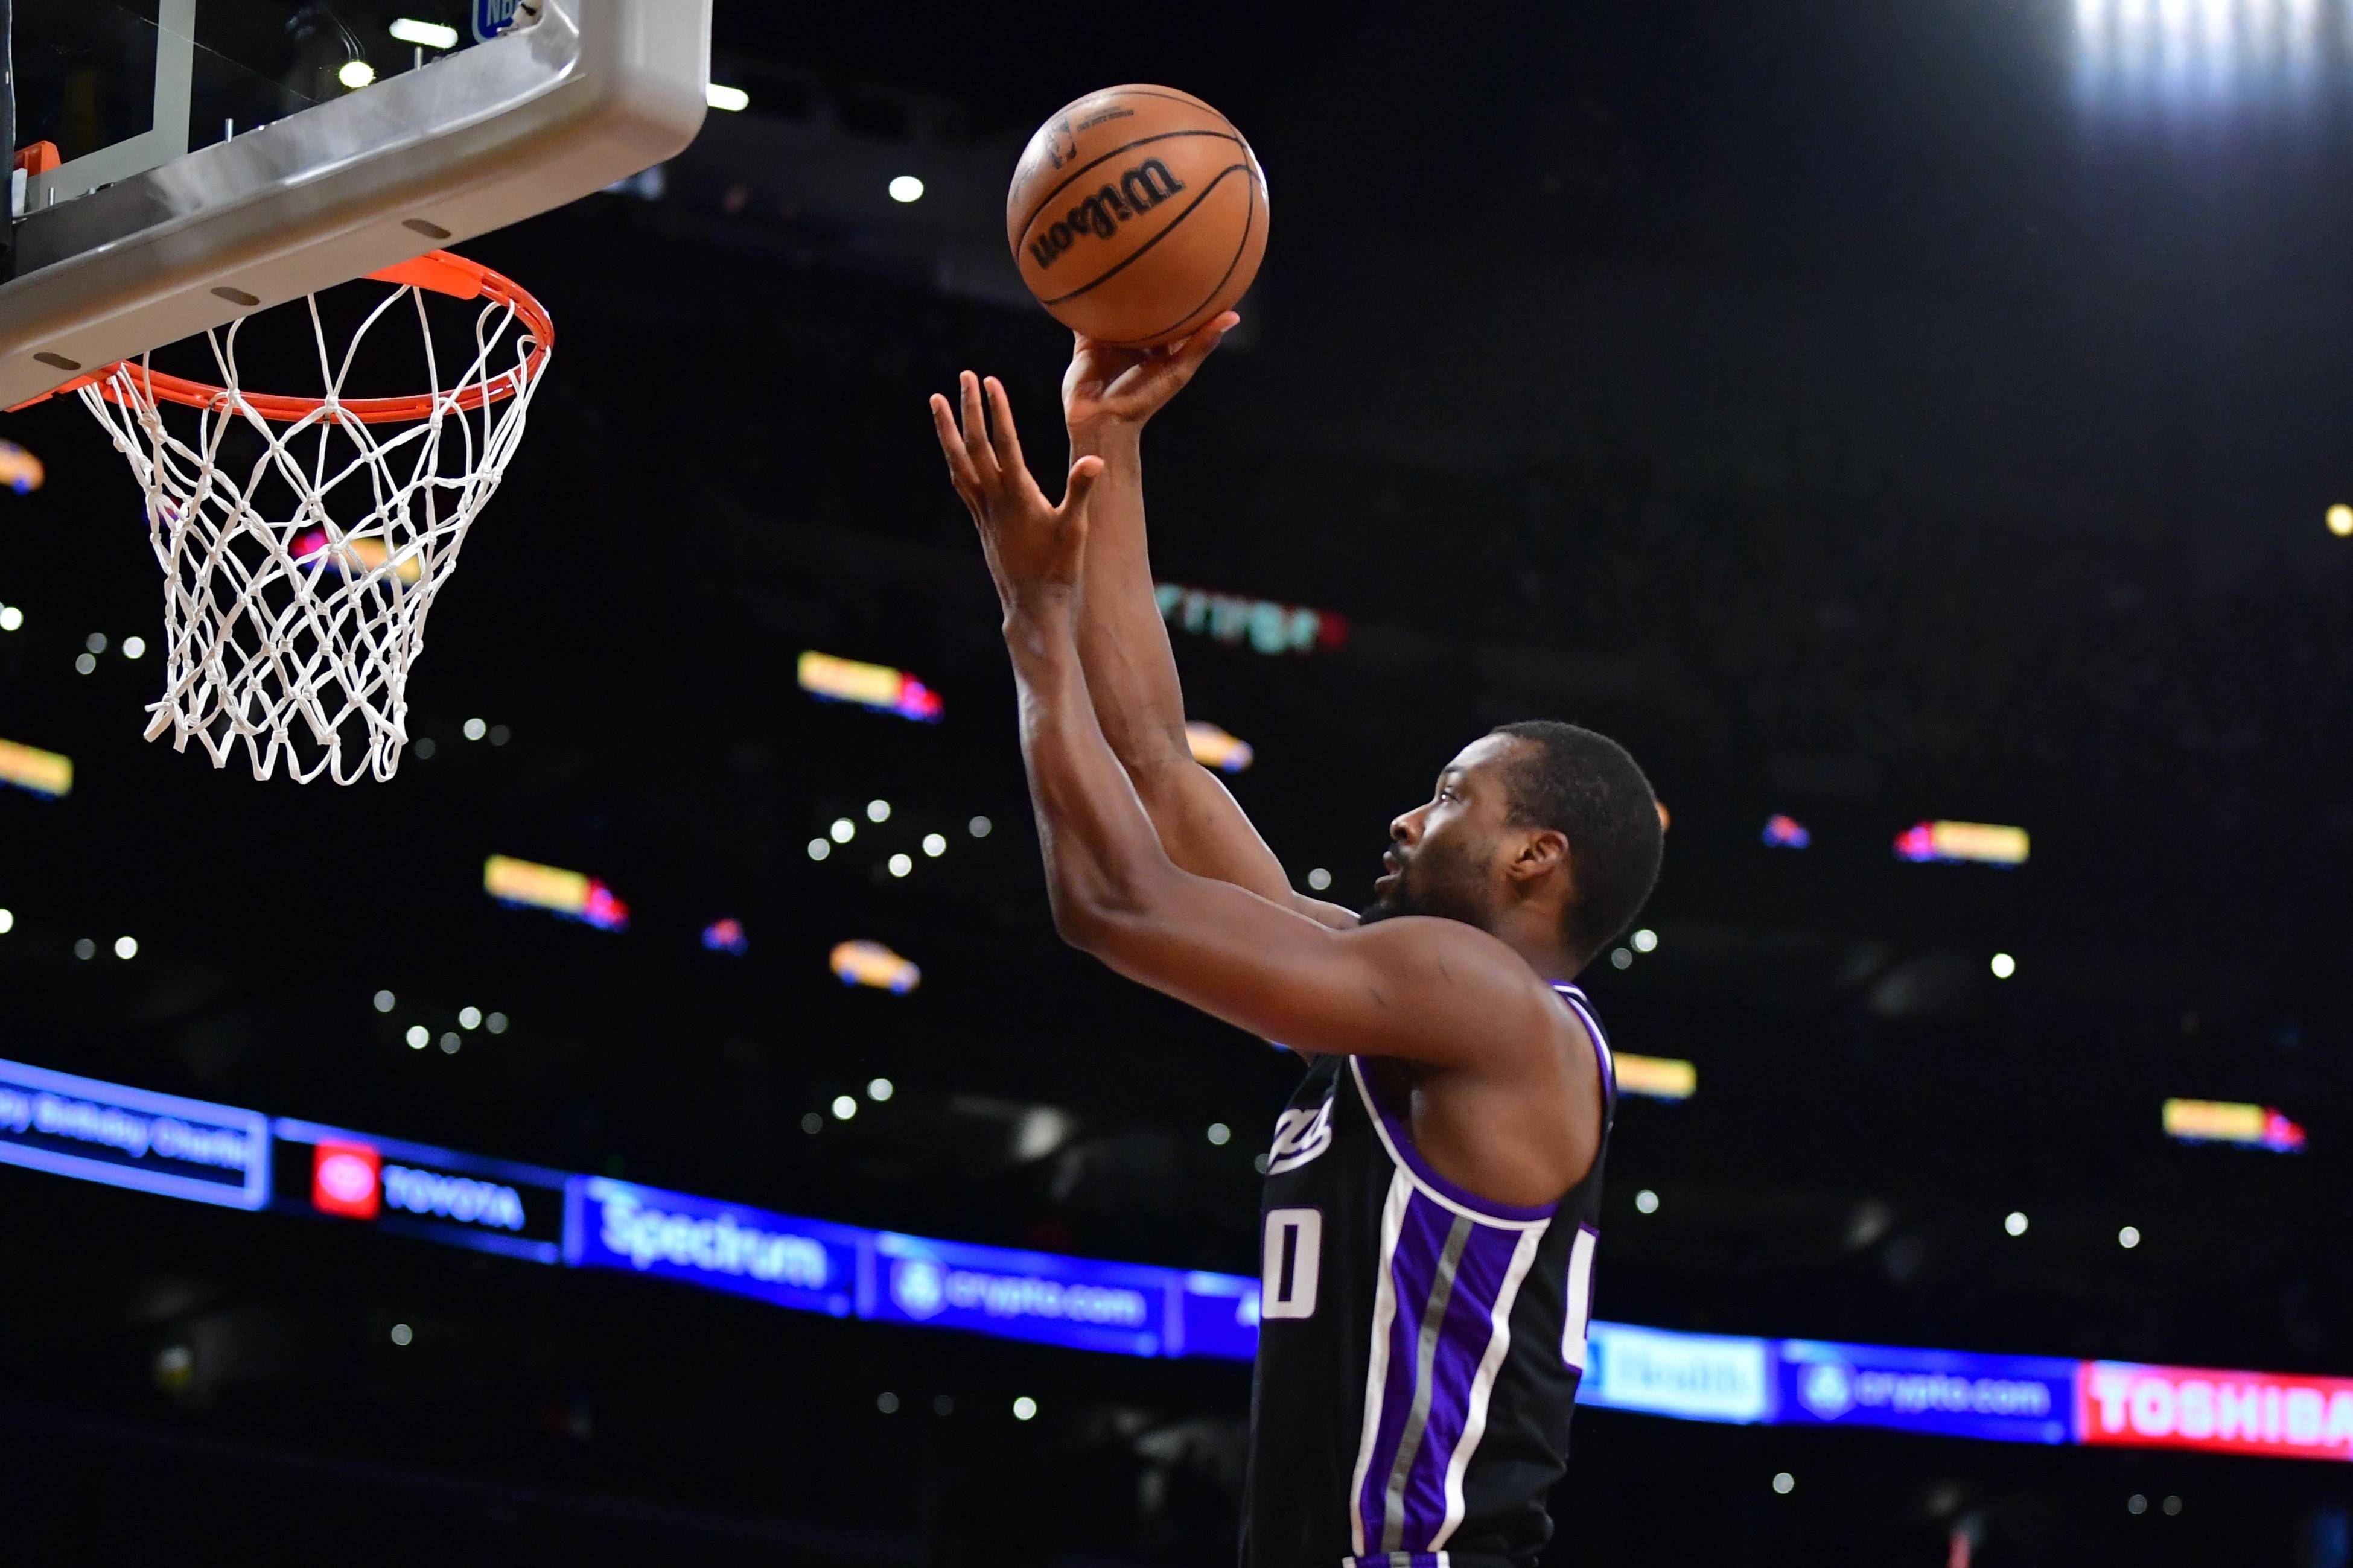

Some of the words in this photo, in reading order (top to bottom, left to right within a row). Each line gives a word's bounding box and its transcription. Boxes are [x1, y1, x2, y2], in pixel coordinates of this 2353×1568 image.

[1029, 157, 1186, 270] Wilson
[382, 1164, 525, 1230] TOYOTA
[600, 1186, 828, 1290] Spectrum
[945, 1269, 1145, 1327] crypto.com
[1853, 1370, 2050, 1417] crypto.com
[2090, 1373, 2353, 1447] TOSHIBA
